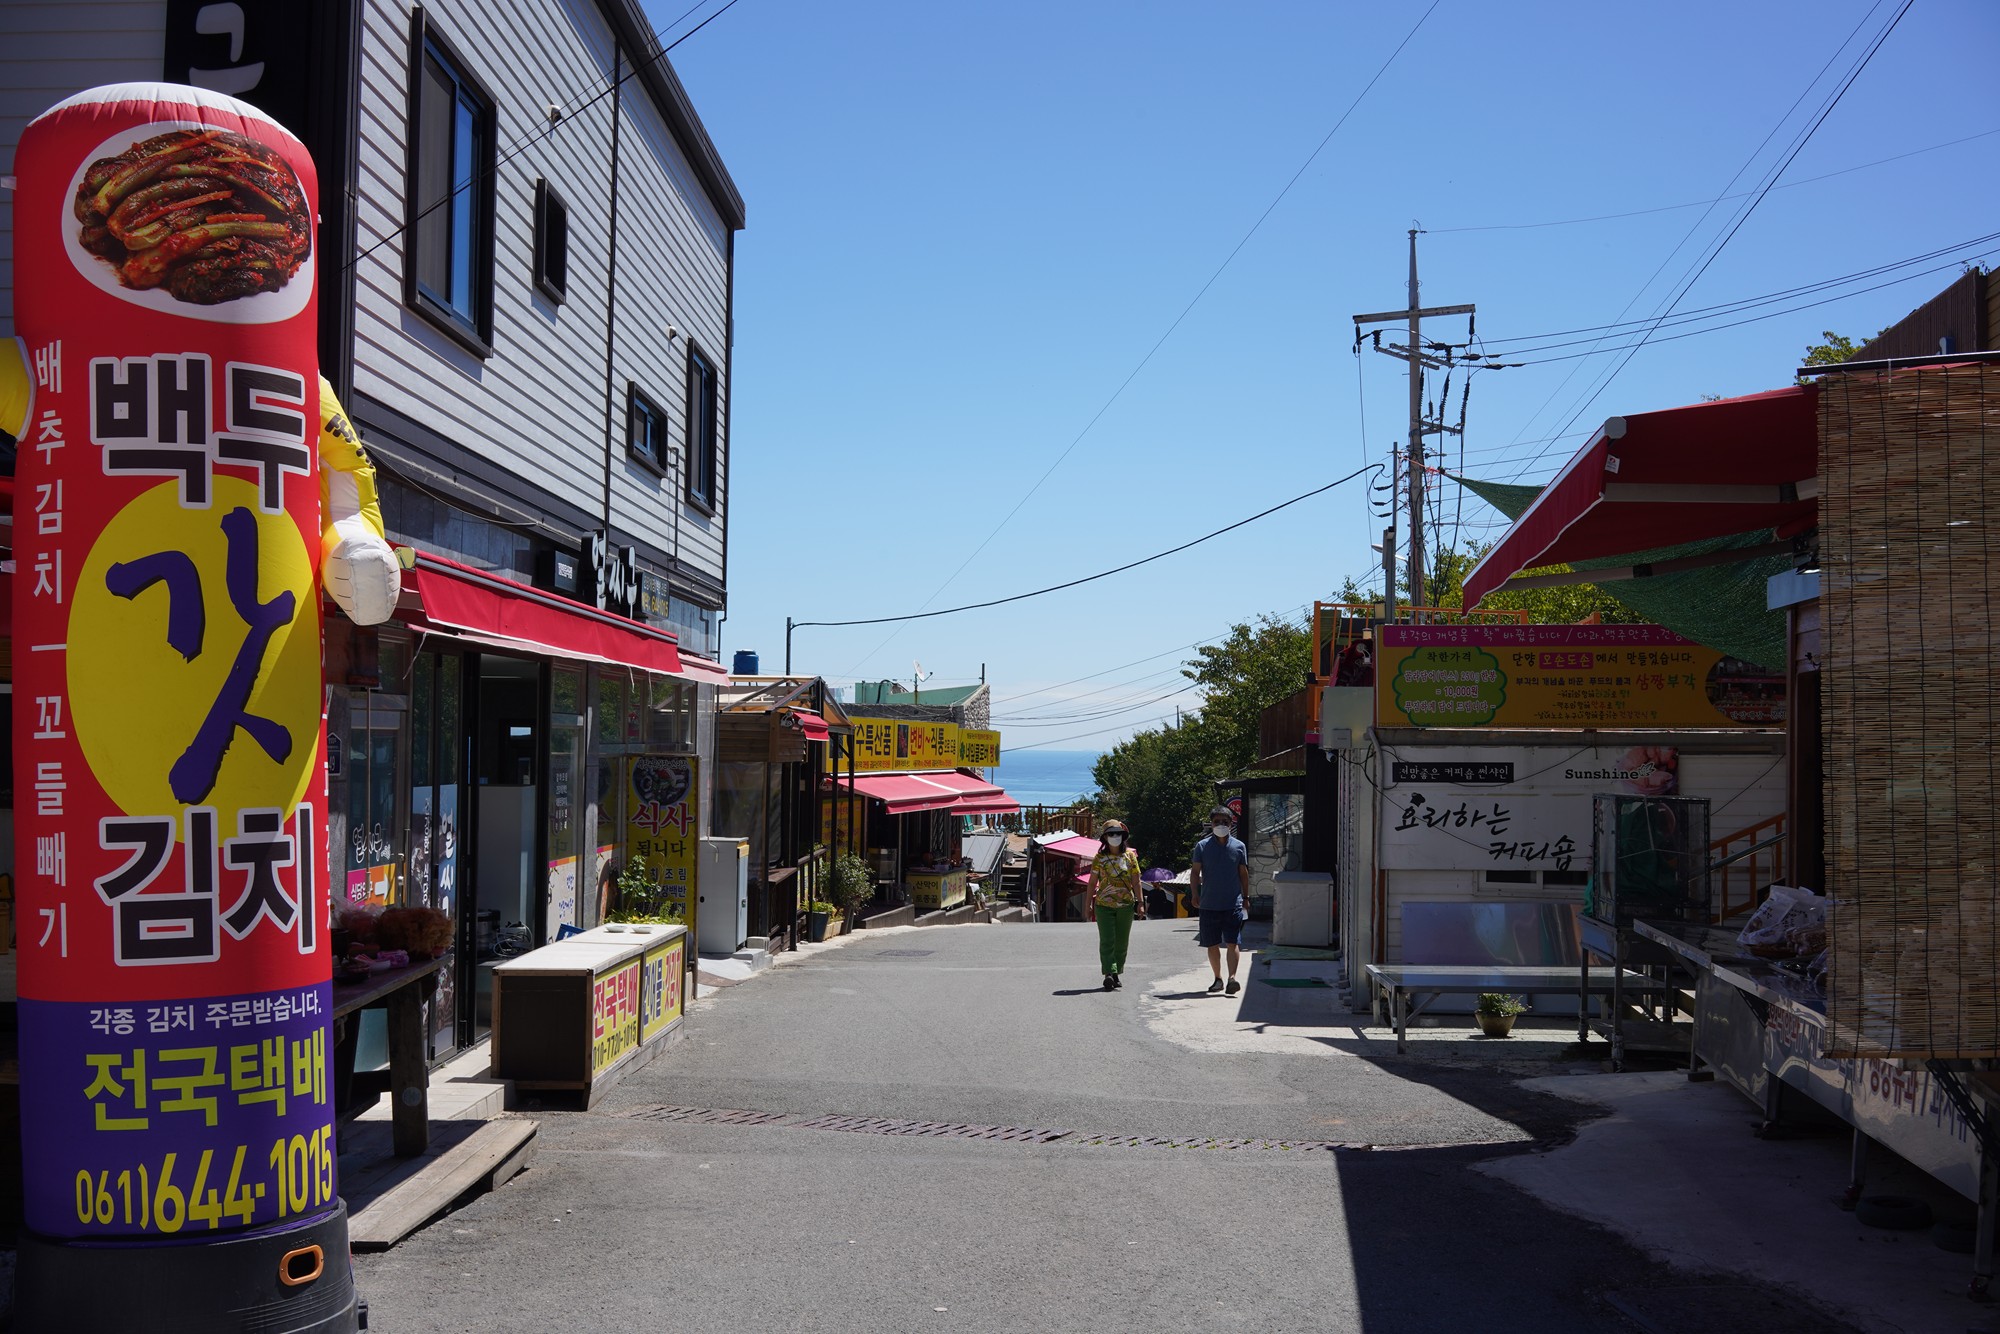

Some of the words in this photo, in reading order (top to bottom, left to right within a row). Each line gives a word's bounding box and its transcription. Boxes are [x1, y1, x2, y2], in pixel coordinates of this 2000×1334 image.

[89, 353, 311, 514] 백두
[34, 340, 65, 604] 배추김치
[1400, 629, 1431, 642] 부각의
[1436, 628, 1468, 642] 개념을
[105, 506, 297, 806] 갓
[1427, 651, 1472, 663] 착한가격
[1512, 652, 1536, 667] 단양
[1542, 654, 1592, 668] 오손도손
[1596, 652, 1619, 664] 에서
[1516, 676, 1540, 686] 부각의
[1542, 676, 1565, 686] 개념을
[1567, 676, 1584, 686] 바꾼
[1588, 676, 1613, 686] 푸드의
[1615, 676, 1632, 686] 품격
[1404, 700, 1437, 714] 푸짐하게
[1456, 701, 1489, 713] 드립니다
[1399, 765, 1441, 780] 전망좋은
[1477, 765, 1509, 779] 썬샤인
[1564, 768, 1640, 781] Sunshine
[33, 695, 67, 957] 꼬들빼기
[631, 801, 697, 837] 식사
[1394, 802, 1511, 836] 요리하는
[636, 840, 687, 858] 됩니다
[94, 801, 315, 967] 김치
[89, 1007, 136, 1036] 각종
[146, 1004, 195, 1033] 김치
[205, 989, 323, 1030] 주문받습니다.
[593, 963, 639, 1040] 전국택배
[83, 1026, 328, 1131] 전국택배
[75, 1122, 333, 1233] 061)644-1015
